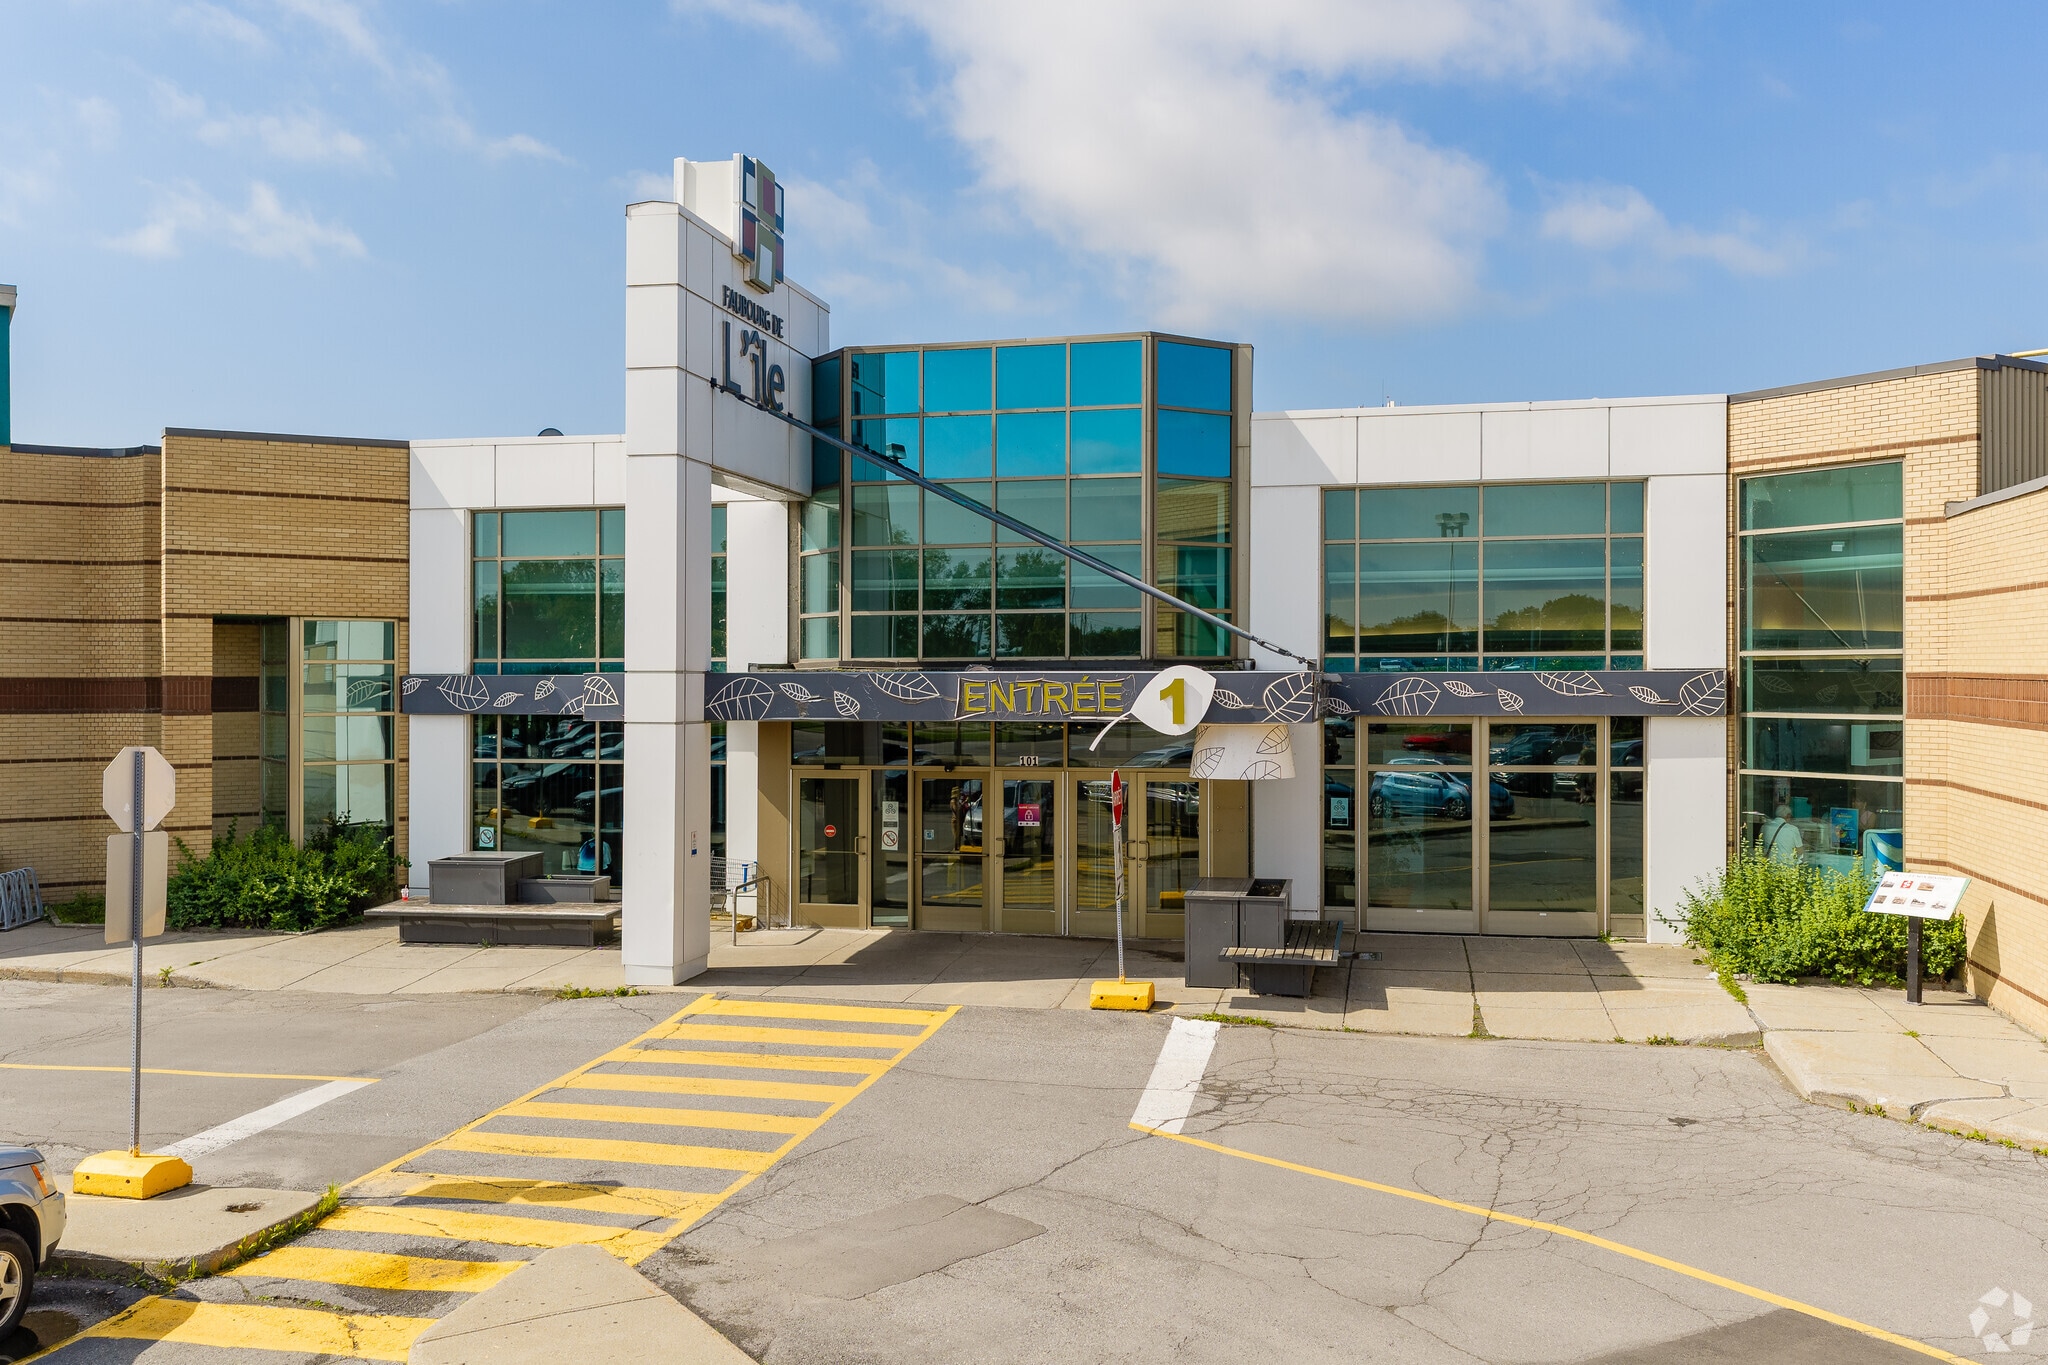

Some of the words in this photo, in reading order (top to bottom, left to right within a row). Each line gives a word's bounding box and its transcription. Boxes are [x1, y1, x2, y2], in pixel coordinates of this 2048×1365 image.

[722, 284, 771, 332] FAUBOURG
[771, 314, 784, 339] DE
[963, 675, 1125, 712] ENTRÉE
[1159, 678, 1186, 725] 1
[1020, 756, 1038, 766] 101
